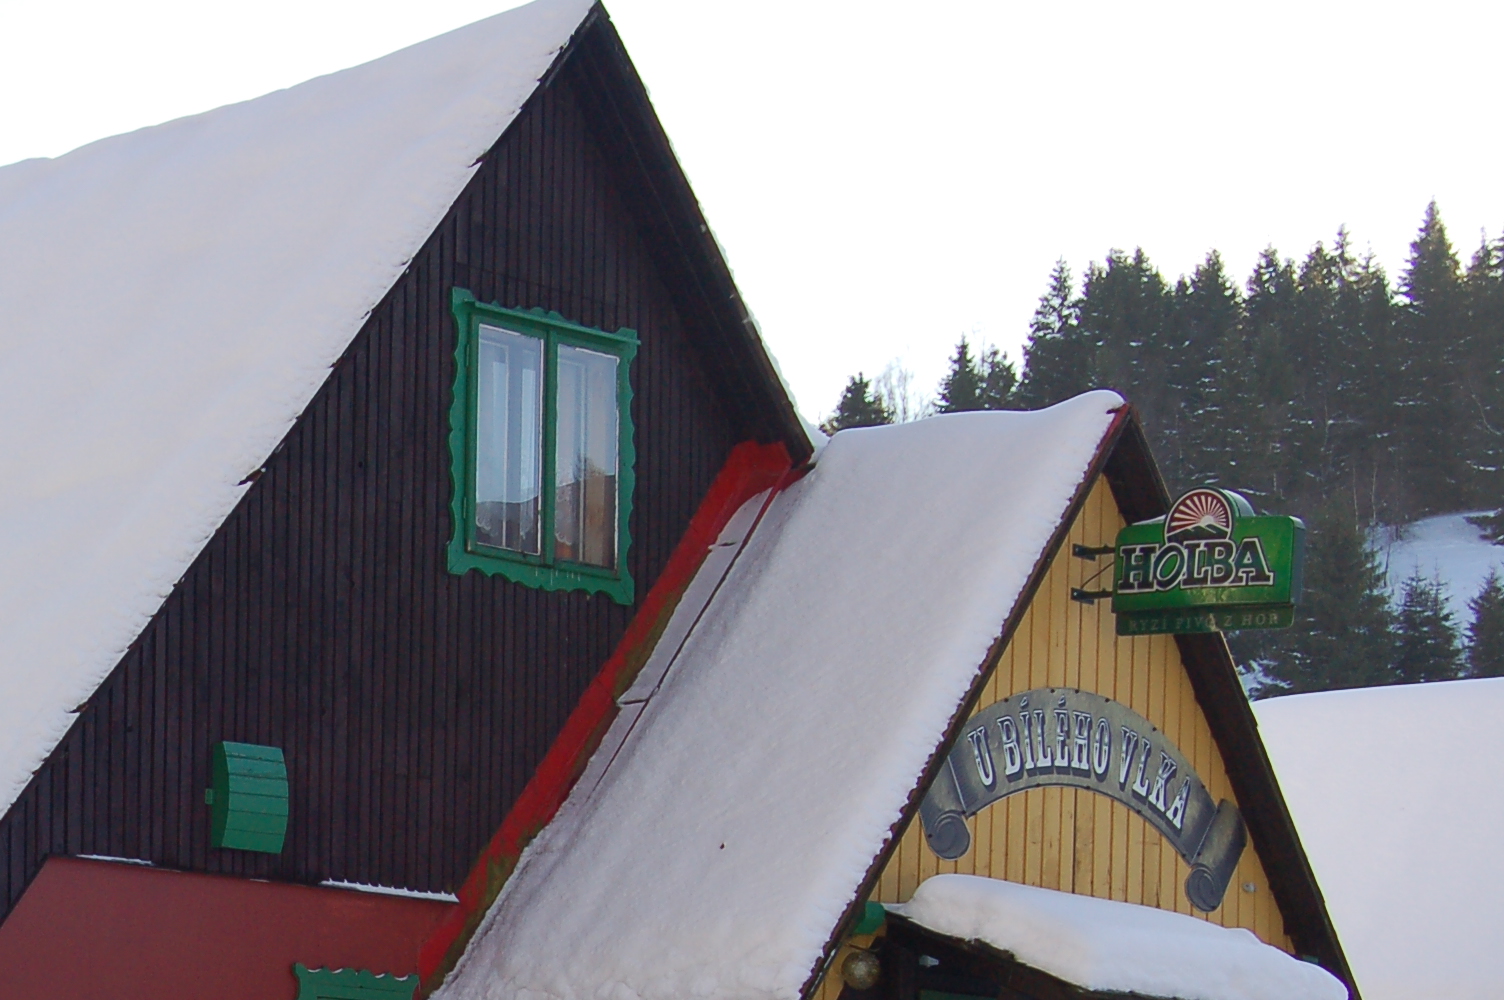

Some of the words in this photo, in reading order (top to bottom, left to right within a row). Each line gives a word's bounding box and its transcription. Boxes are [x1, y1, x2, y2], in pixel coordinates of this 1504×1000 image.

[1117, 537, 1275, 594] HOLBA
[1223, 615, 1234, 627] Z
[1241, 612, 1280, 627] HOR
[967, 725, 994, 787] U
[997, 694, 1112, 778] BÍLÉHO
[1119, 726, 1192, 831] VLKA
